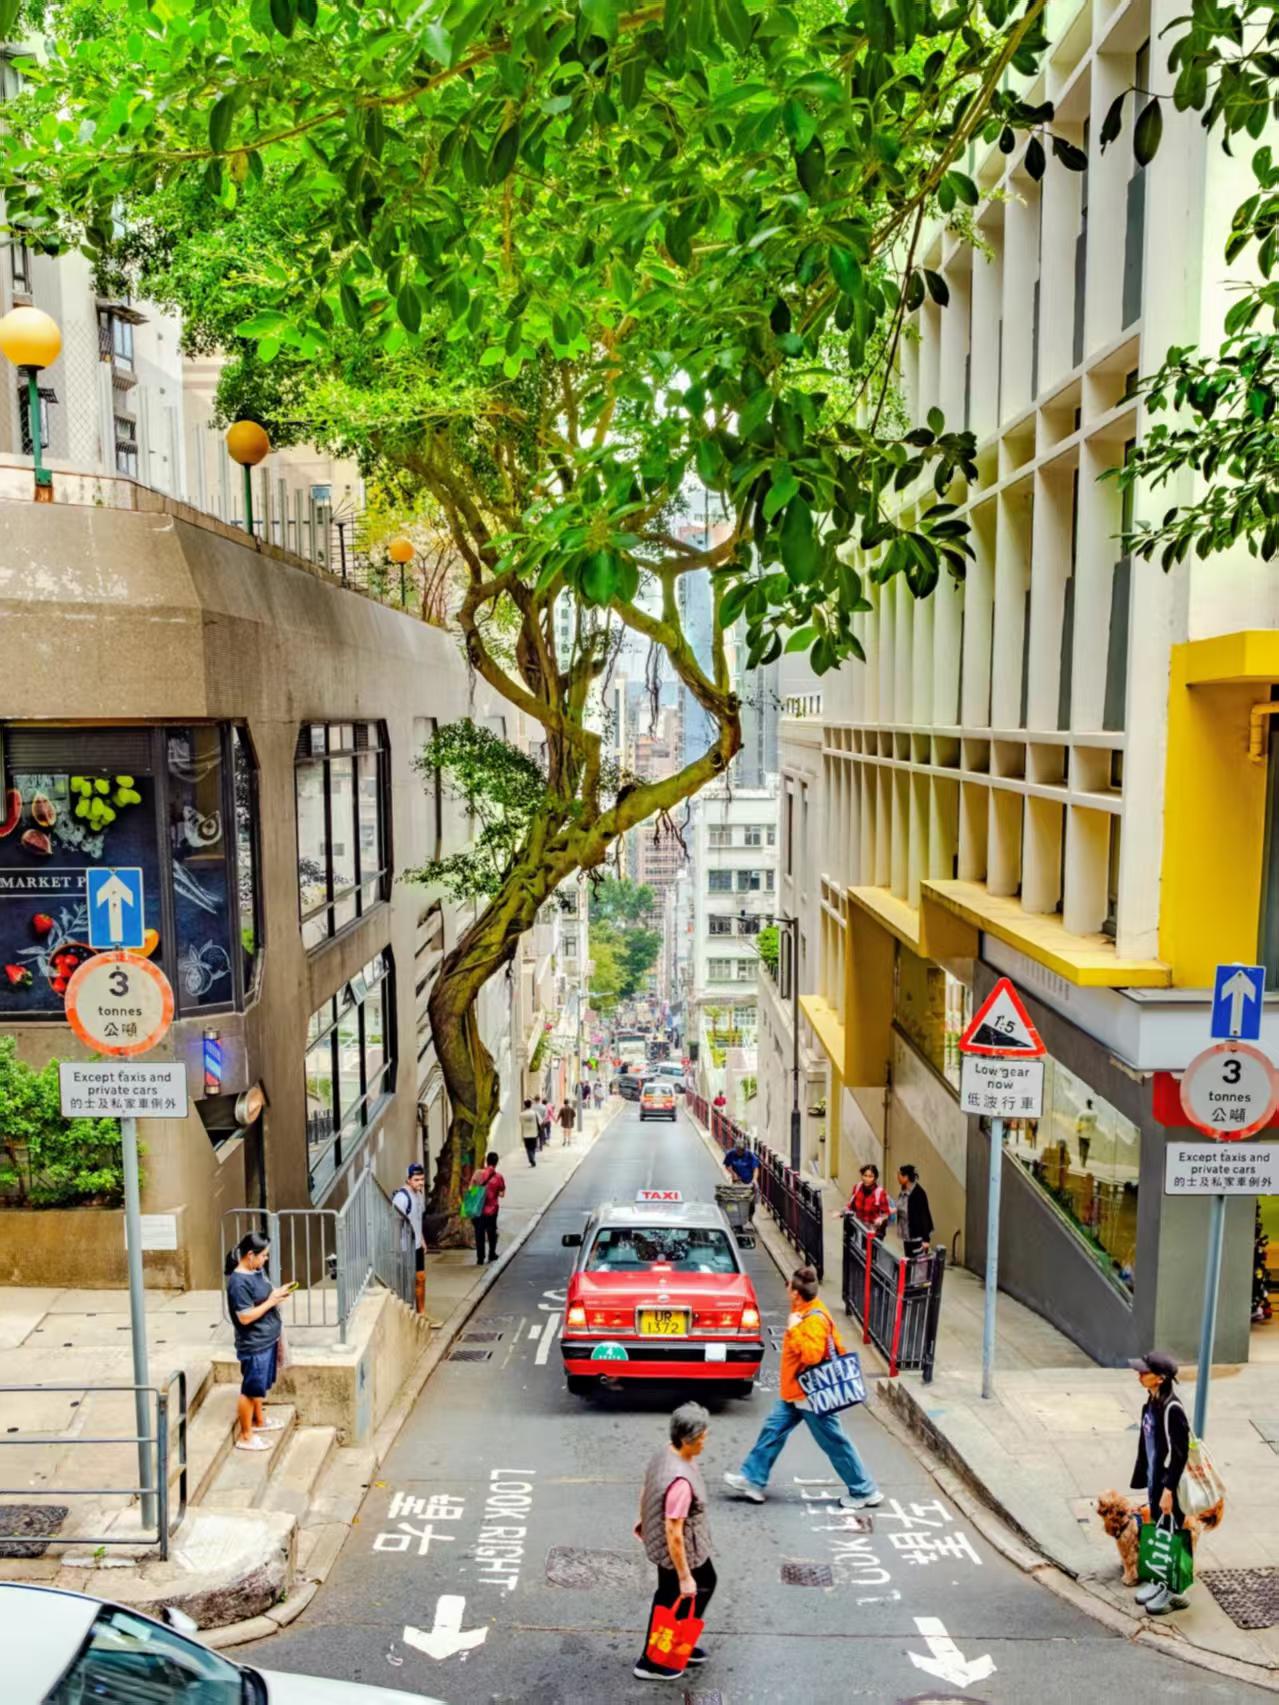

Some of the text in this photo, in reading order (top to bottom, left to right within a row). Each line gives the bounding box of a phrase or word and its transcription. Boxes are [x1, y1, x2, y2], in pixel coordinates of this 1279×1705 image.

[0, 876, 72, 889] MARKET
[108, 970, 129, 997] 3
[98, 1006, 142, 1016] tonnes
[104, 1022, 138, 1037] 公噸
[975, 1063, 1030, 1079] Low gear
[1222, 1059, 1242, 1084] 3
[73, 1071, 172, 1085] Except taxis and
[987, 1080, 1014, 1089] now
[88, 1085, 158, 1096] private cars
[1208, 1090, 1252, 1102] tonnes
[70, 1098, 176, 1110] 的士及私家車例外
[1211, 1107, 1246, 1123] 公噸
[1178, 1151, 1271, 1164] Except taxis and
[1190, 1165, 1256, 1175] private cars
[1173, 1176, 1272, 1188] 的士及私家車例外
[641, 1191, 679, 1200] TAXI
[654, 1311, 673, 1322] UR
[647, 1322, 680, 1334] 1372
[372, 1491, 465, 1556] 望右
[475, 1469, 537, 1591] LOOK RIGHT
[876, 1498, 983, 1565] 望左
